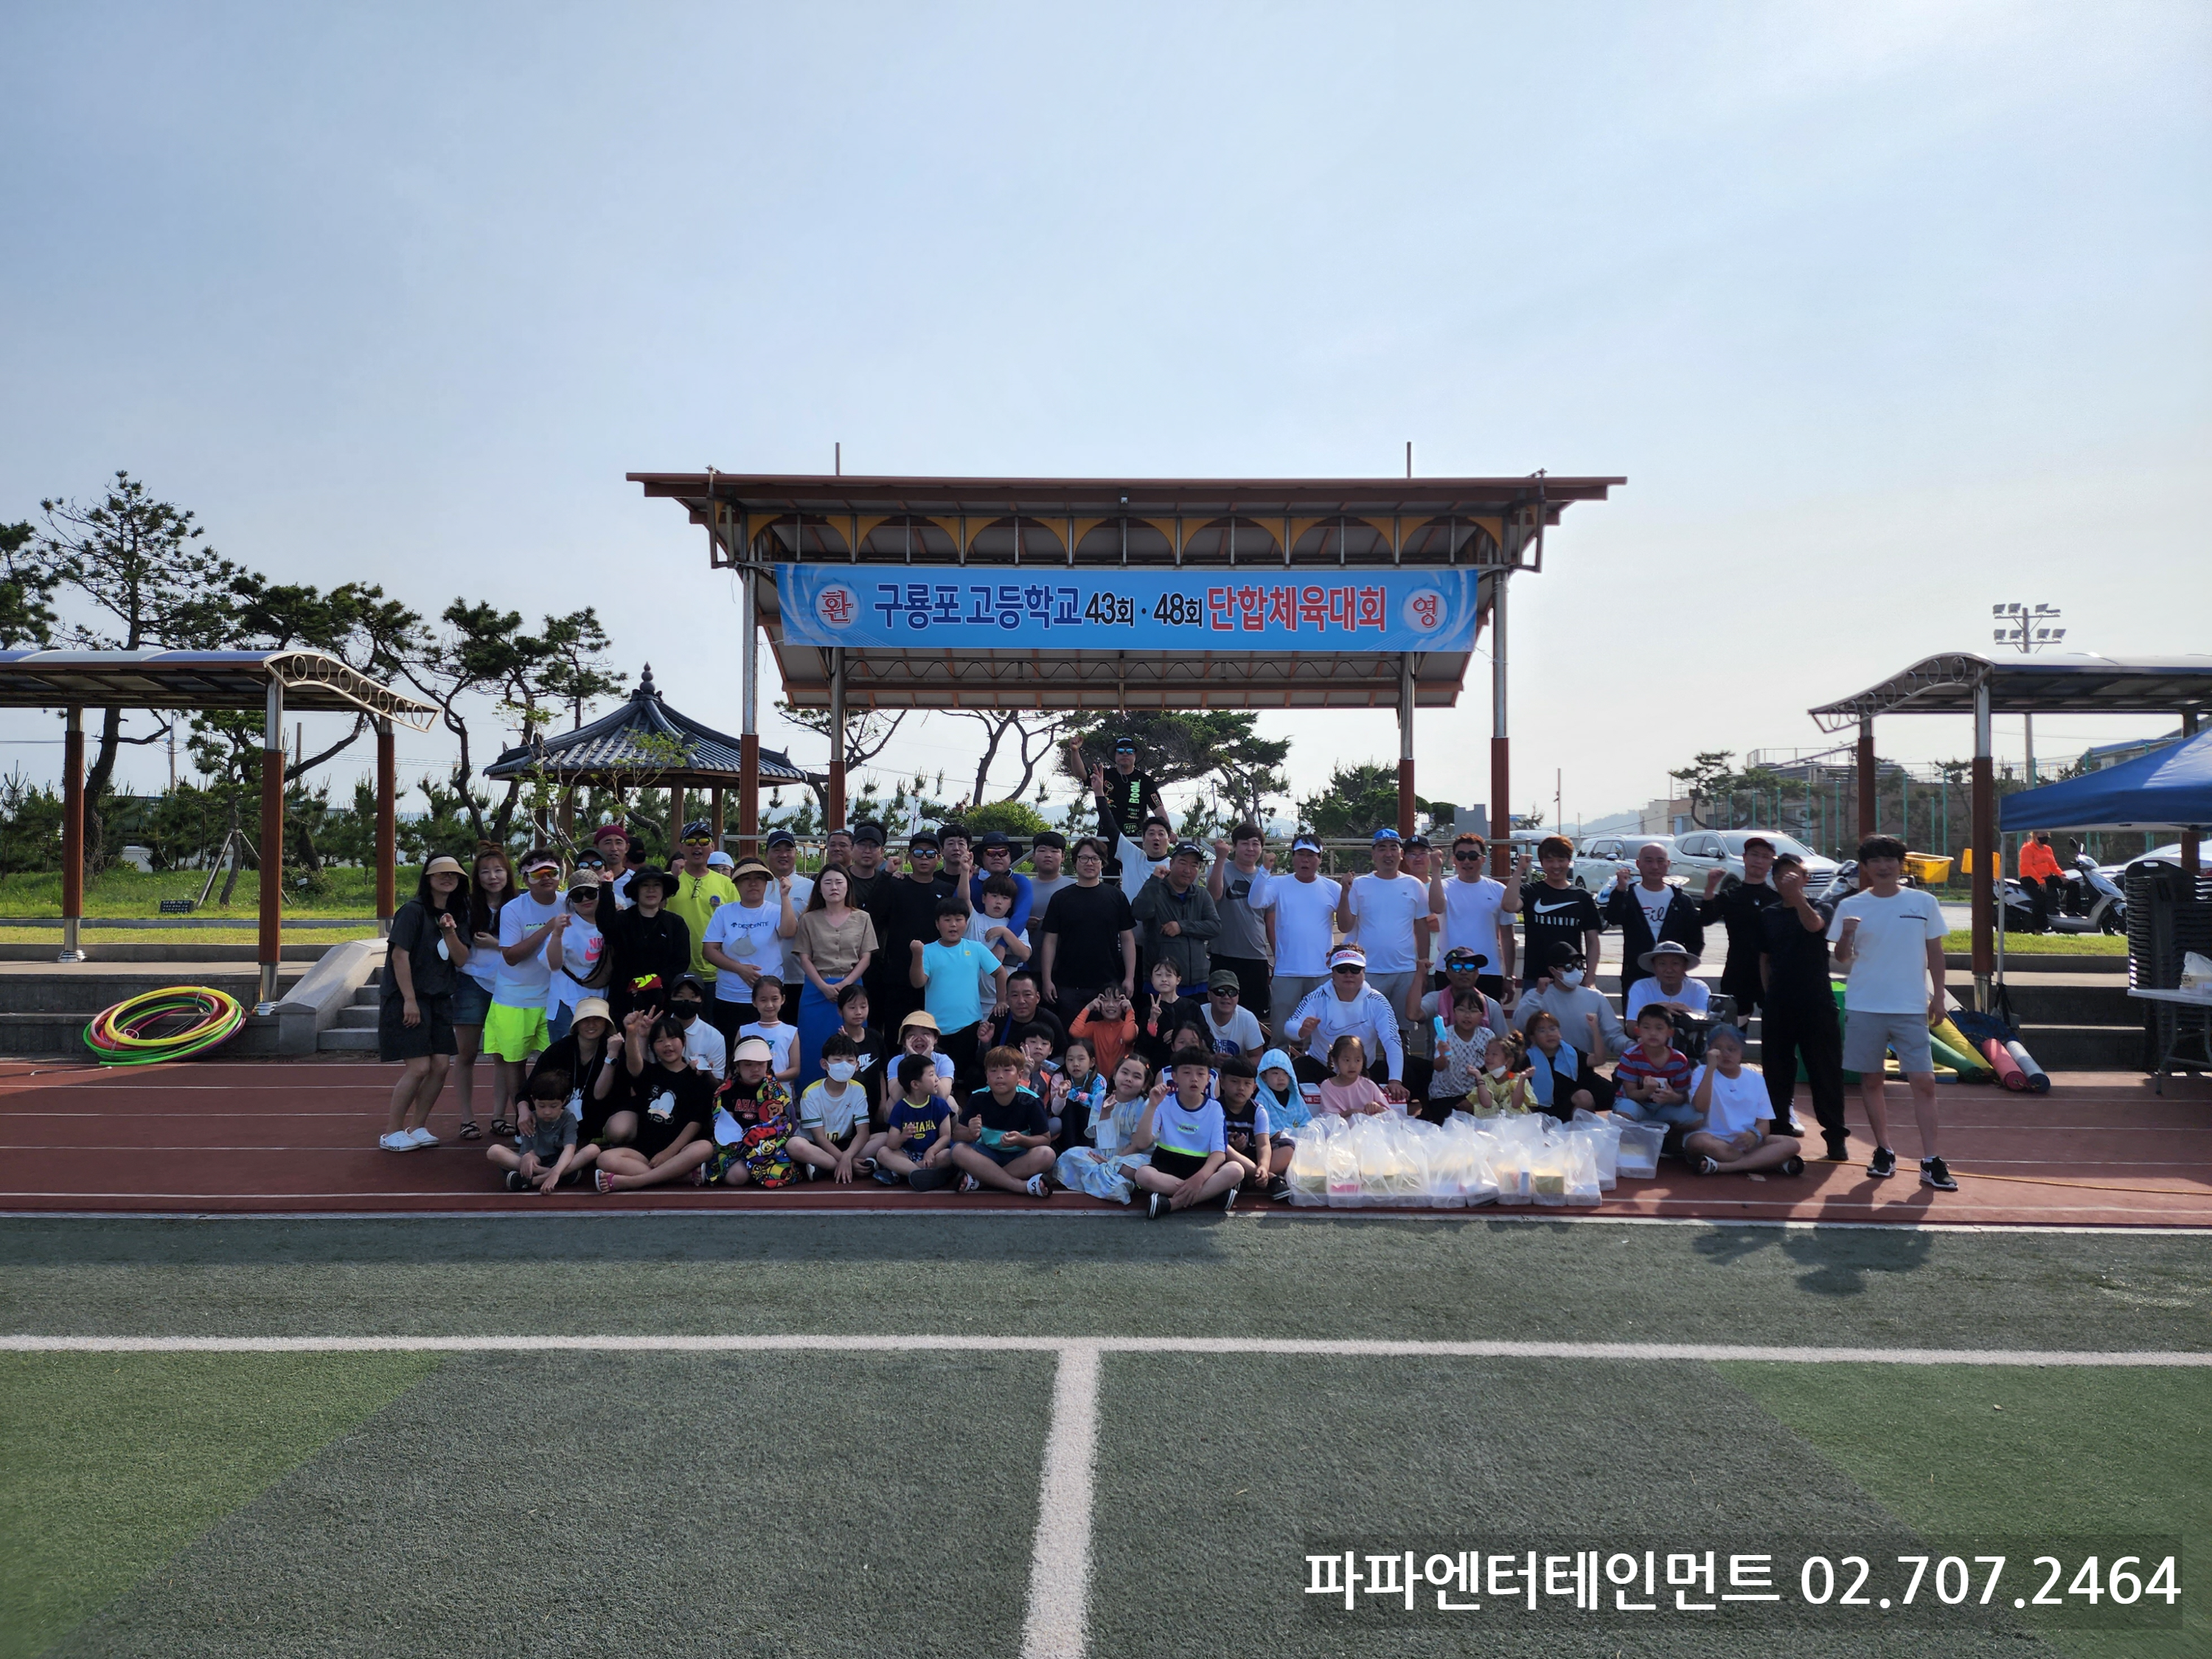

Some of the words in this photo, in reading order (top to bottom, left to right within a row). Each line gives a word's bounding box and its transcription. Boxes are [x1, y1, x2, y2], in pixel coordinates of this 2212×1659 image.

[821, 589, 854, 624] 환
[874, 582, 962, 630] 구룡포
[965, 584, 1083, 630] 고등학교
[1084, 592, 1135, 627] 43회
[1152, 593, 1203, 627] 48회
[1207, 585, 1386, 633] 단합체육대회
[1412, 594, 1438, 627] 영
